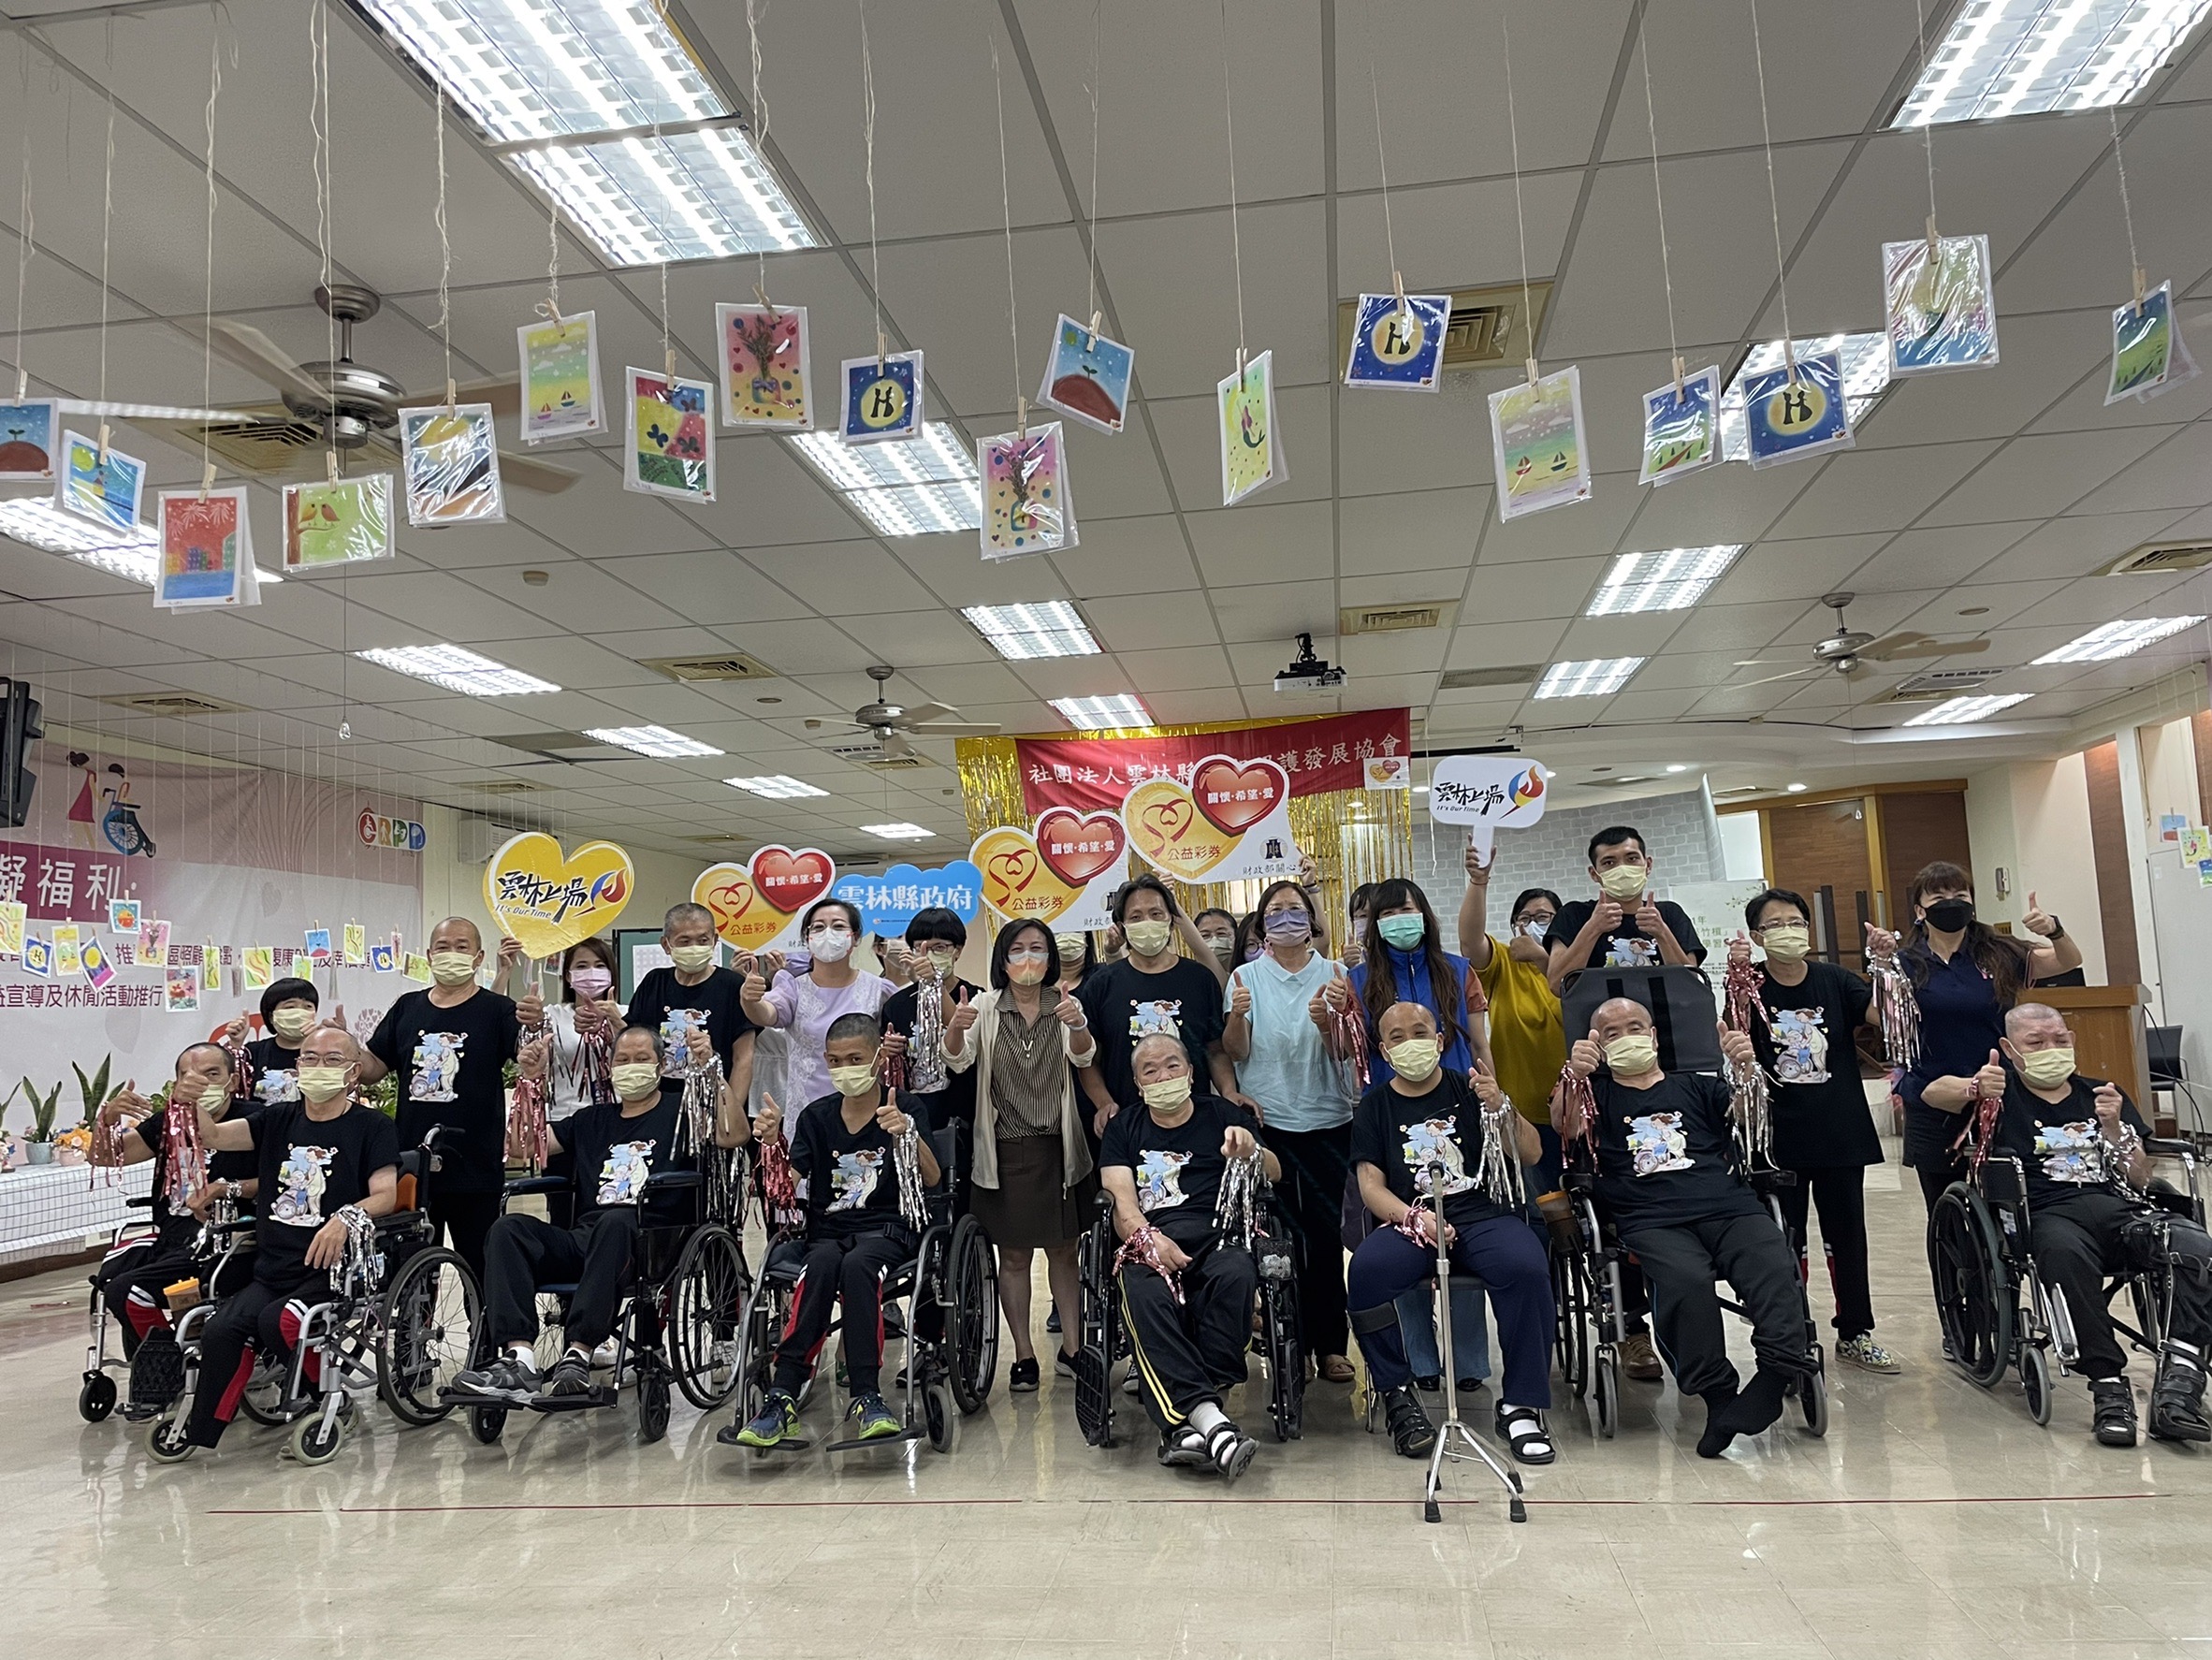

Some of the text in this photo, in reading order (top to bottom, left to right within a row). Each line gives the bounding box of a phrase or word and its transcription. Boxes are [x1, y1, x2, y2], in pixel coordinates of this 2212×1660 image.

[1167, 845, 1221, 861] 公益彩券
[837, 884, 973, 910] 雲林縣政府
[1012, 896, 1065, 910] 公益彩券
[530, 909, 552, 919] Time
[730, 922, 777, 936] 公益彩券
[0, 984, 163, 1008] 宣導及休閒活動推行
